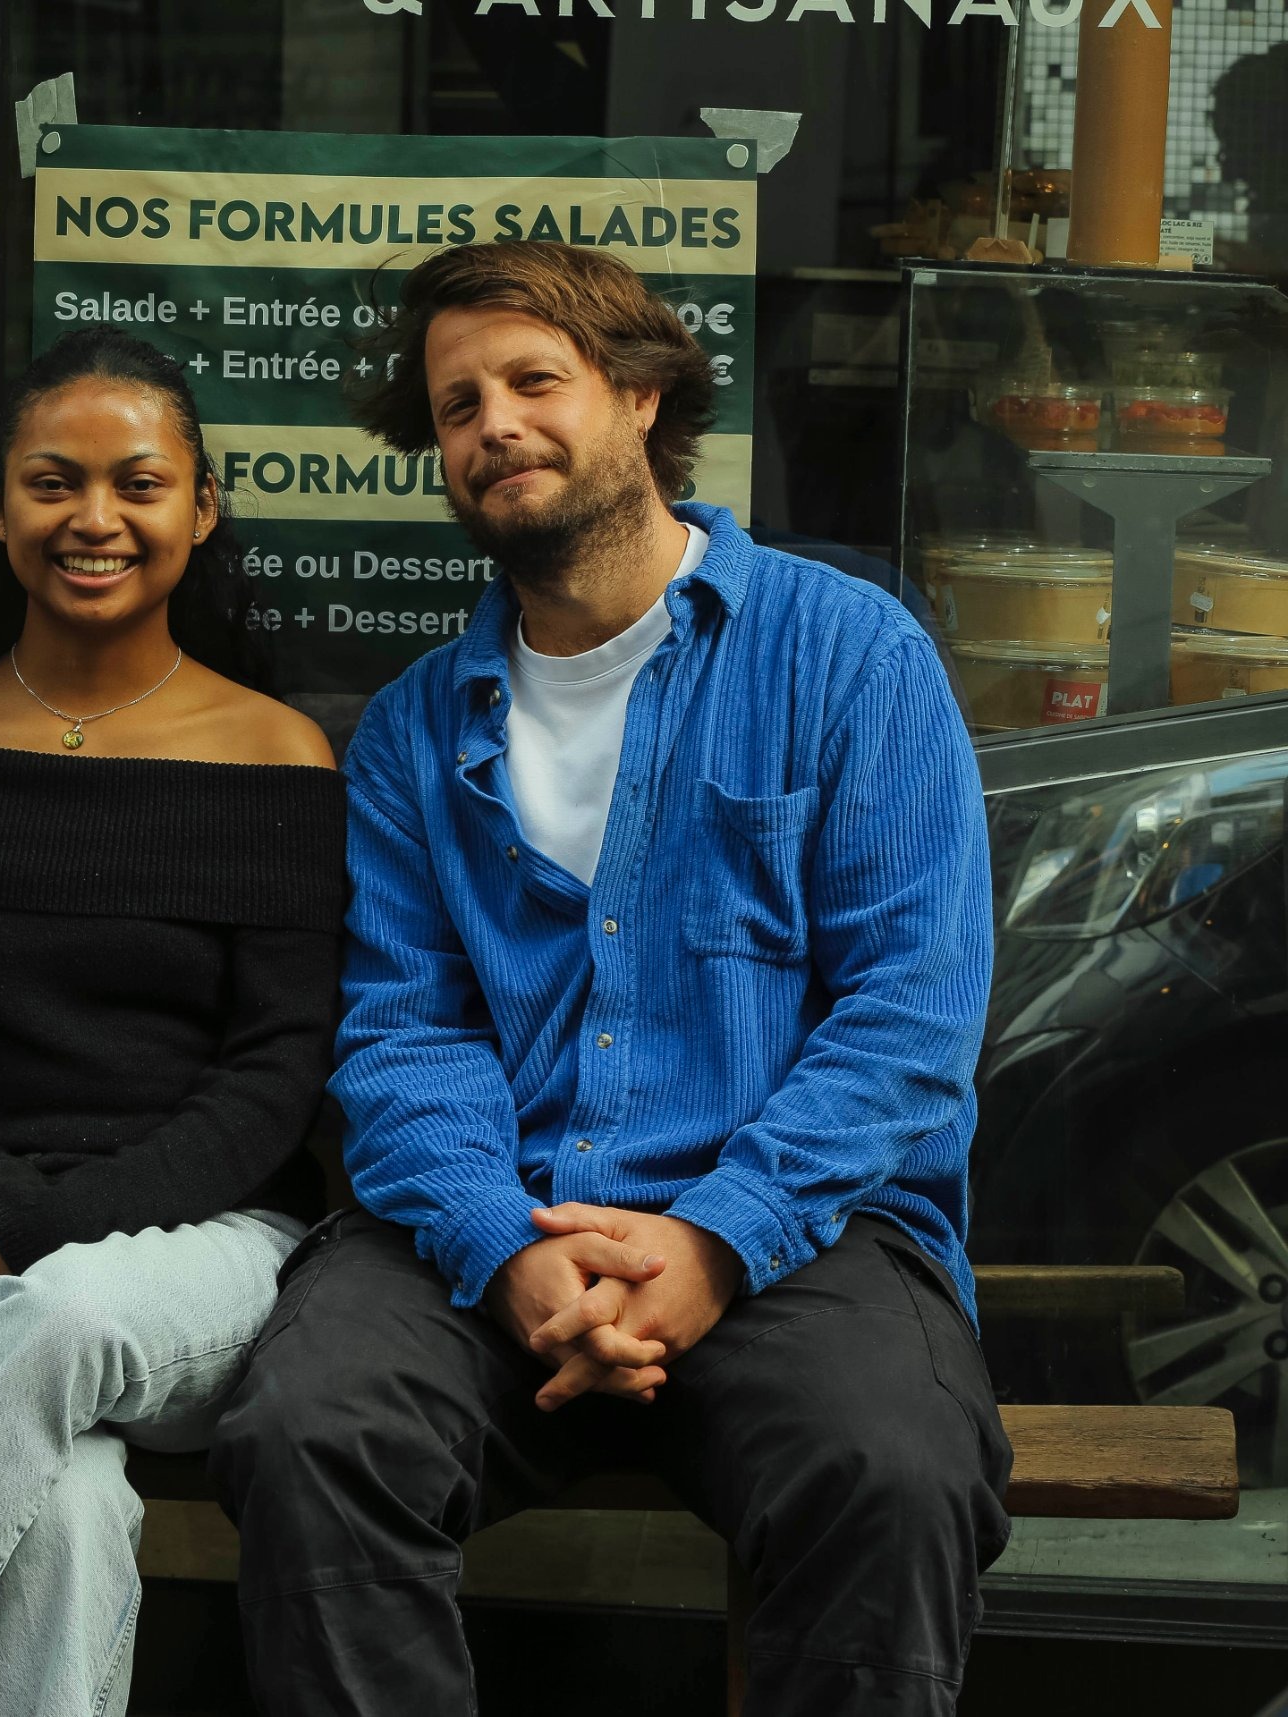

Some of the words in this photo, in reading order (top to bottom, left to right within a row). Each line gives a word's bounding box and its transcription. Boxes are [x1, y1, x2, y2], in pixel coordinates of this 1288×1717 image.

[56, 195, 171, 239] NOS
[189, 199, 476, 245] FORMULES
[494, 204, 741, 249] SALADES
[54, 291, 177, 323] Salade
[189, 300, 210, 321] +
[223, 297, 341, 327] Entrée
[189, 353, 210, 374] +
[223, 350, 340, 381] Entrée
[224, 451, 449, 496] FORMUL
[295, 554, 340, 579] ou
[353, 550, 494, 582] Dessert
[294, 607, 315, 629] +
[328, 603, 469, 635] Dessert
[1052, 692, 1093, 708] PLAT
